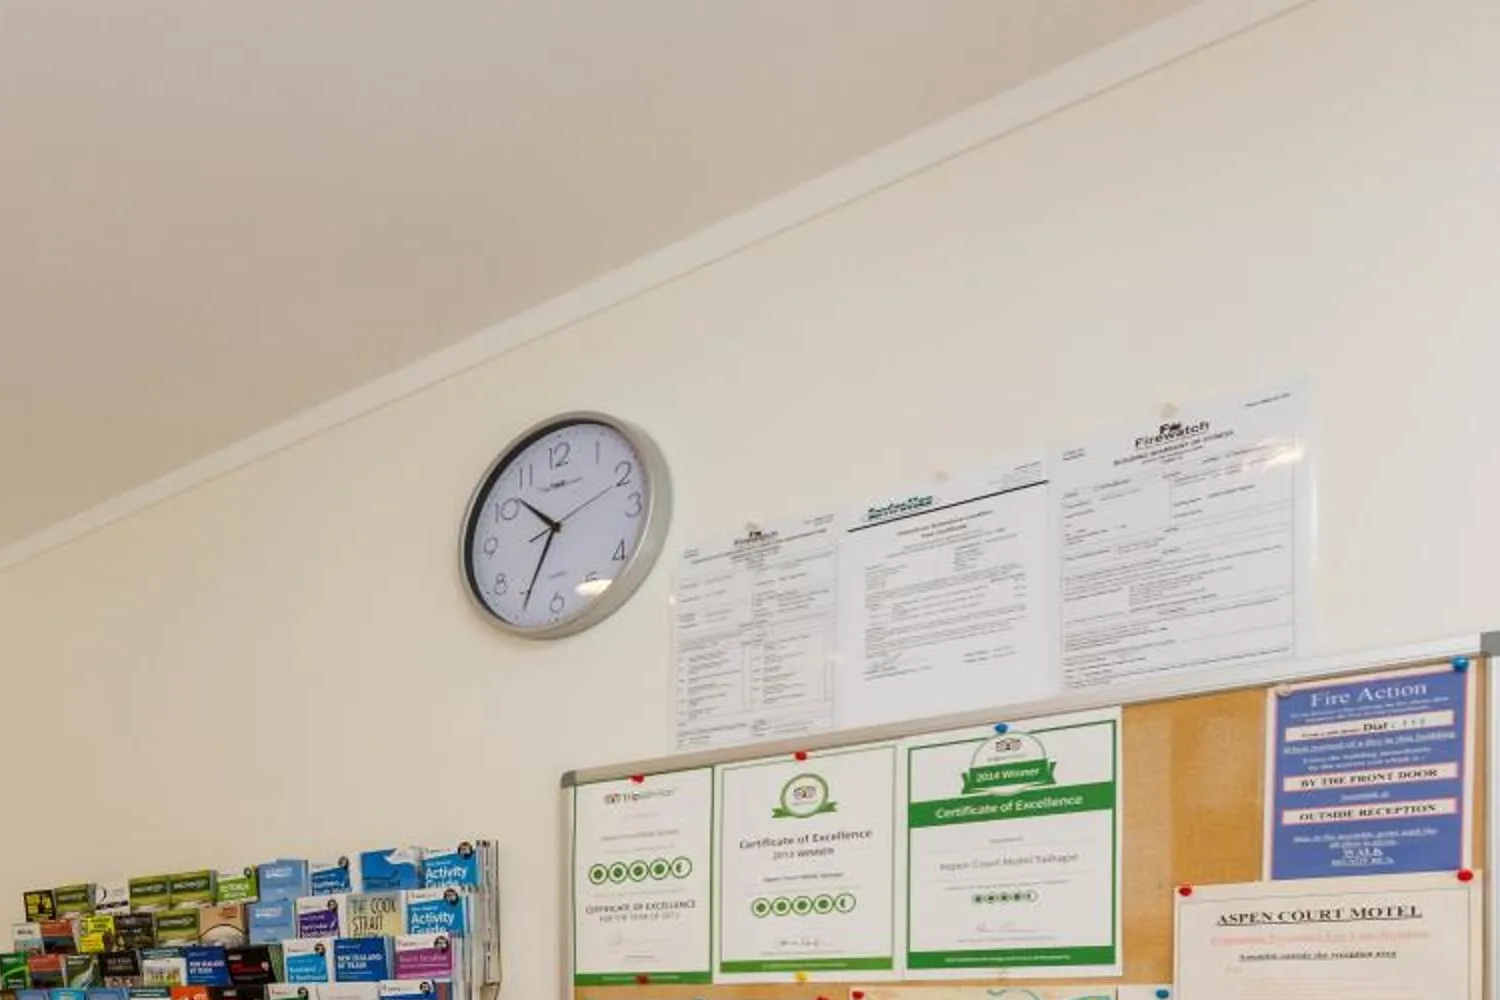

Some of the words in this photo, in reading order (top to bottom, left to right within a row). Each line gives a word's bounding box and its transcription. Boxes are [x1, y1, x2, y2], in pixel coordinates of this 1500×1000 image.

[1135, 421, 1209, 448] Firewatch
[549, 442, 571, 469] 12
[519, 464, 534, 489] 11
[615, 461, 632, 486] 2
[494, 498, 520, 523] 10
[626, 492, 643, 518] 3
[483, 537, 499, 560] 9
[612, 538, 627, 561] 4
[494, 573, 508, 595] 8
[550, 592, 565, 614] 6
[1310, 691, 1350, 707] Fire
[1357, 684, 1427, 702] Action
[1363, 721, 1389, 731] Dial
[976, 771, 1001, 783] 2014
[1001, 767, 1040, 780] Winner
[1301, 779, 1315, 788] BY
[1322, 777, 1345, 786] THE
[1350, 773, 1393, 784] FRONT
[1398, 769, 1438, 779] DOOR
[935, 804, 998, 820] Certificate
[999, 800, 1014, 813] of
[1015, 795, 1084, 811] Excellence
[1299, 810, 1353, 820] OUTSIDE
[1359, 804, 1436, 816] RECEPTION
[739, 836, 795, 850] Certificate
[797, 834, 809, 844] of
[812, 829, 873, 843] Excellence
[425, 865, 468, 879] Activity
[586, 903, 629, 915] CERTIFICATE
[645, 899, 695, 911] EXCELLENCE
[1217, 912, 1274, 926] ASPEN
[1278, 909, 1347, 922] COURT
[1350, 905, 1422, 920] MOTEL
[411, 912, 454, 925] Activity
